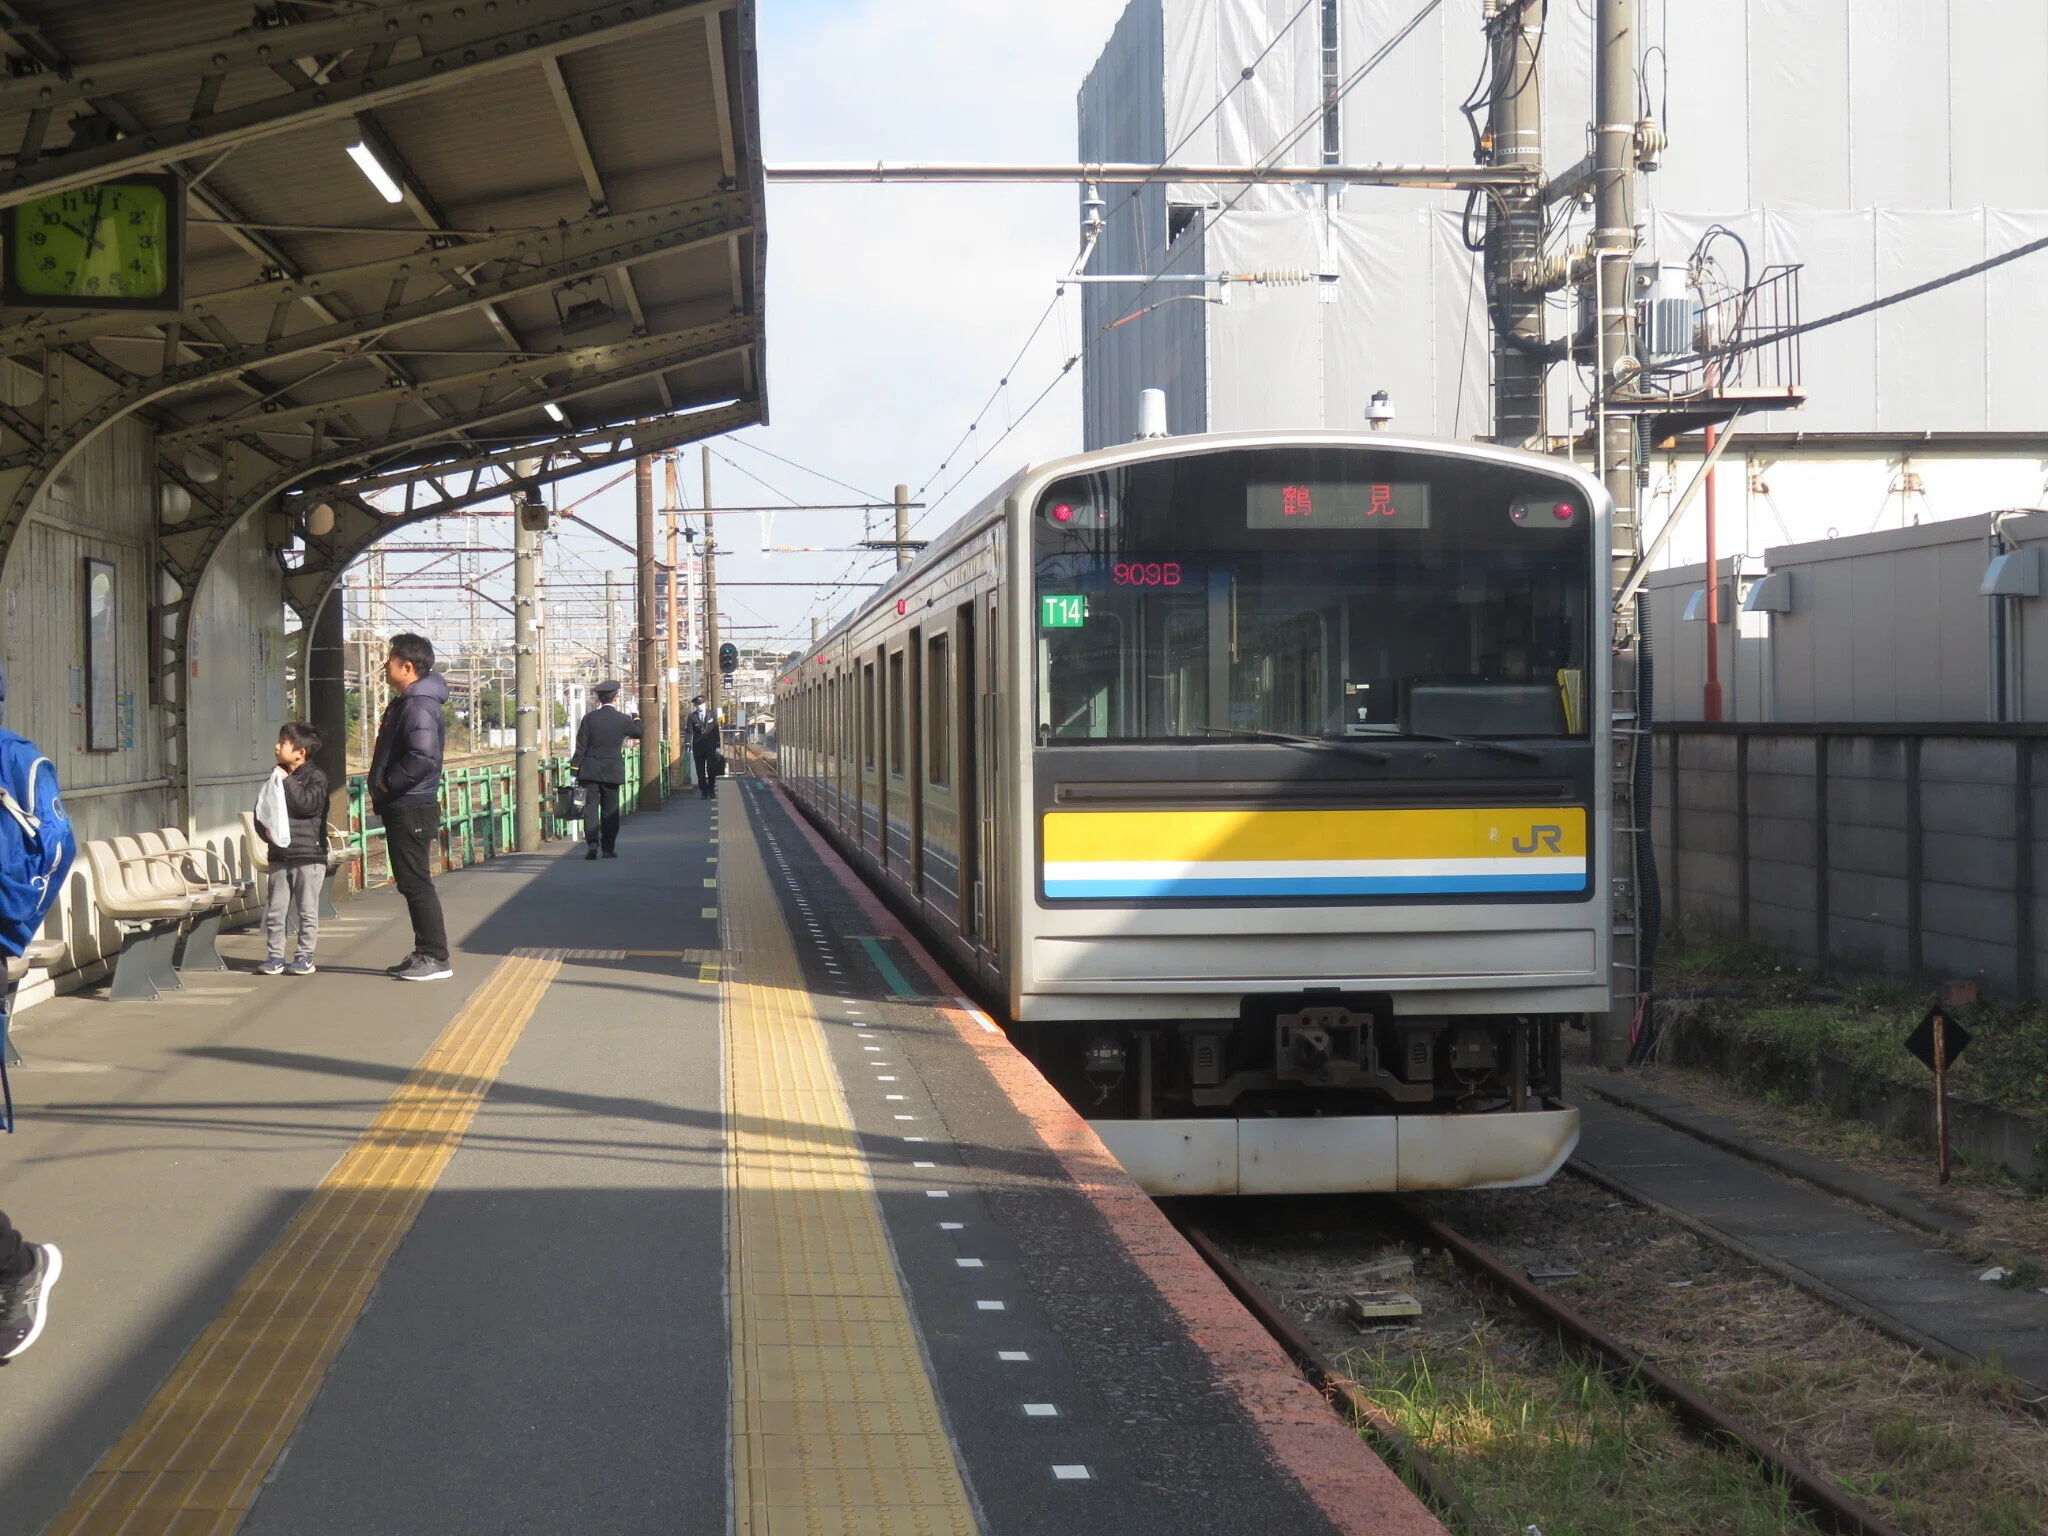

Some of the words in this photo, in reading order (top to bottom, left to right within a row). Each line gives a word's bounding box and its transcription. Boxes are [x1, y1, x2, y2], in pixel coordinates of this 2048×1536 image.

[61, 198, 78, 211] 11
[112, 197, 120, 211] 1
[42, 211, 61, 226] 10
[129, 211, 141, 225] 2
[33, 232, 47, 246] 9
[139, 236, 152, 249] 3
[43, 256, 57, 270] 8
[129, 258, 142, 272] 4
[65, 271, 77, 286] 7
[1282, 484, 1396, 517] 鶴見
[1045, 598, 1081, 625] T14
[1512, 825, 1562, 854] JR
